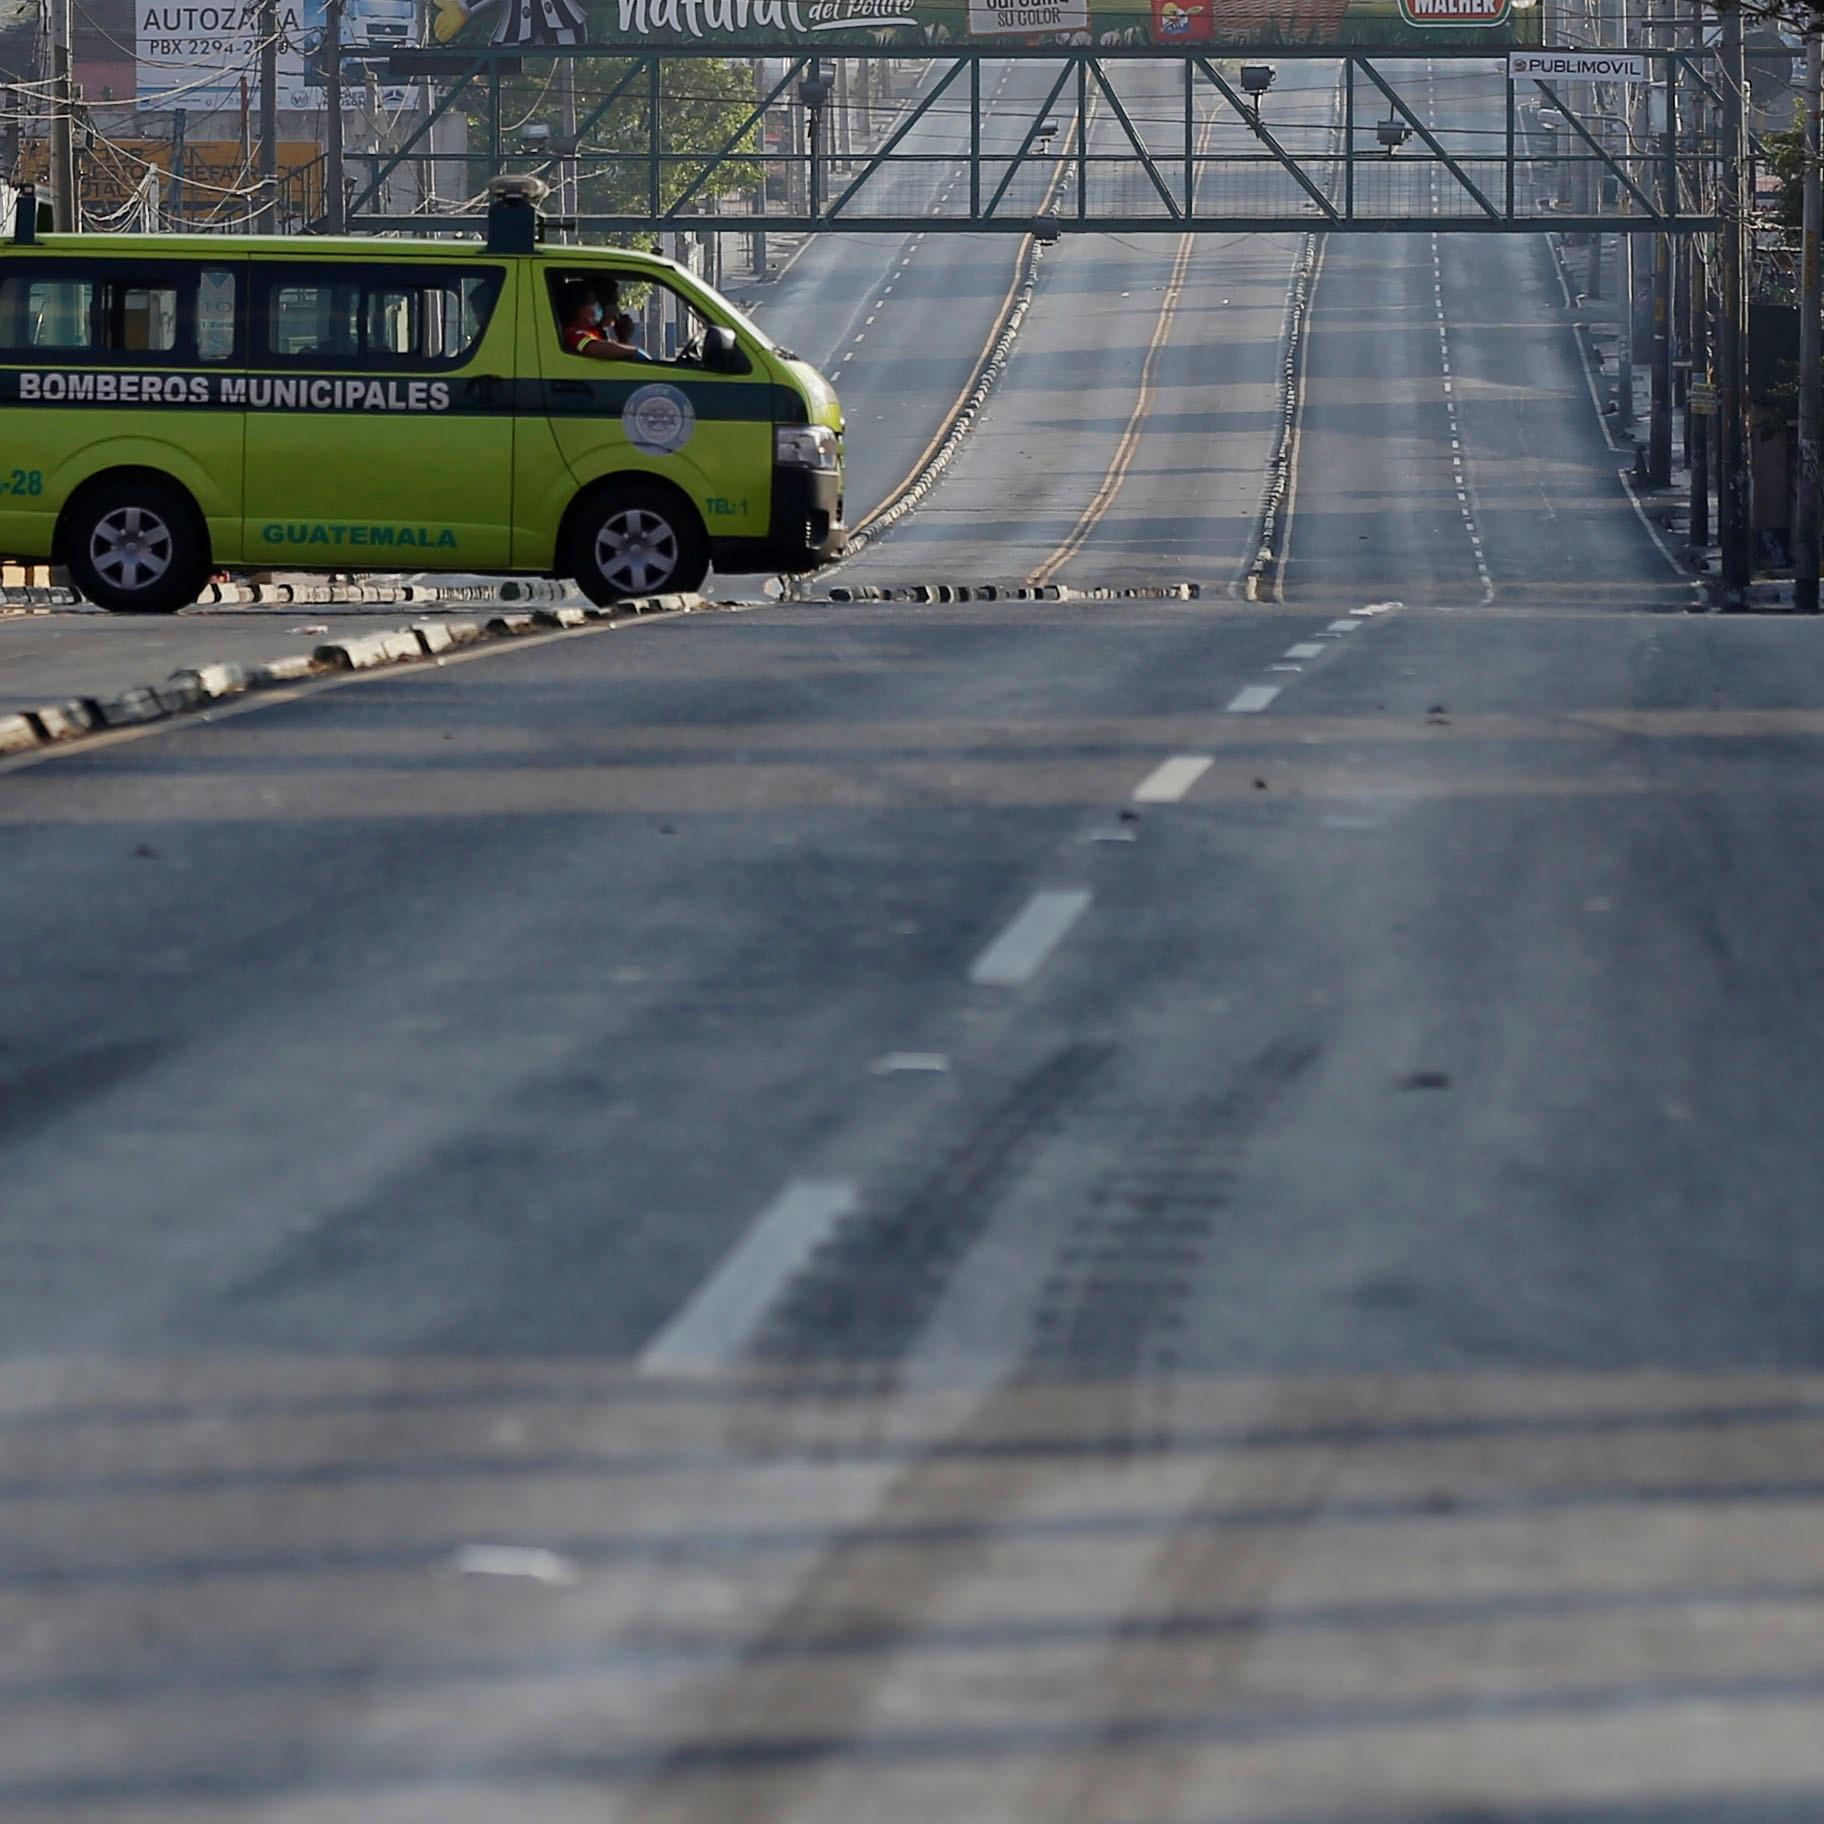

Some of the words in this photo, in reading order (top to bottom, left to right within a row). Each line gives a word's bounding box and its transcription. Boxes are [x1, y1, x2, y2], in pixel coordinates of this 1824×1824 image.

[996, 9, 1015, 27] SU
[1017, 7, 1062, 26] COLOR
[150, 39, 181, 55] PBX
[1528, 59, 1642, 76] PUBLIMOVIL
[18, 372, 210, 404] BOMBEROS
[220, 379, 451, 411] MUNICIPALES
[261, 524, 458, 549] GUATEMALA
